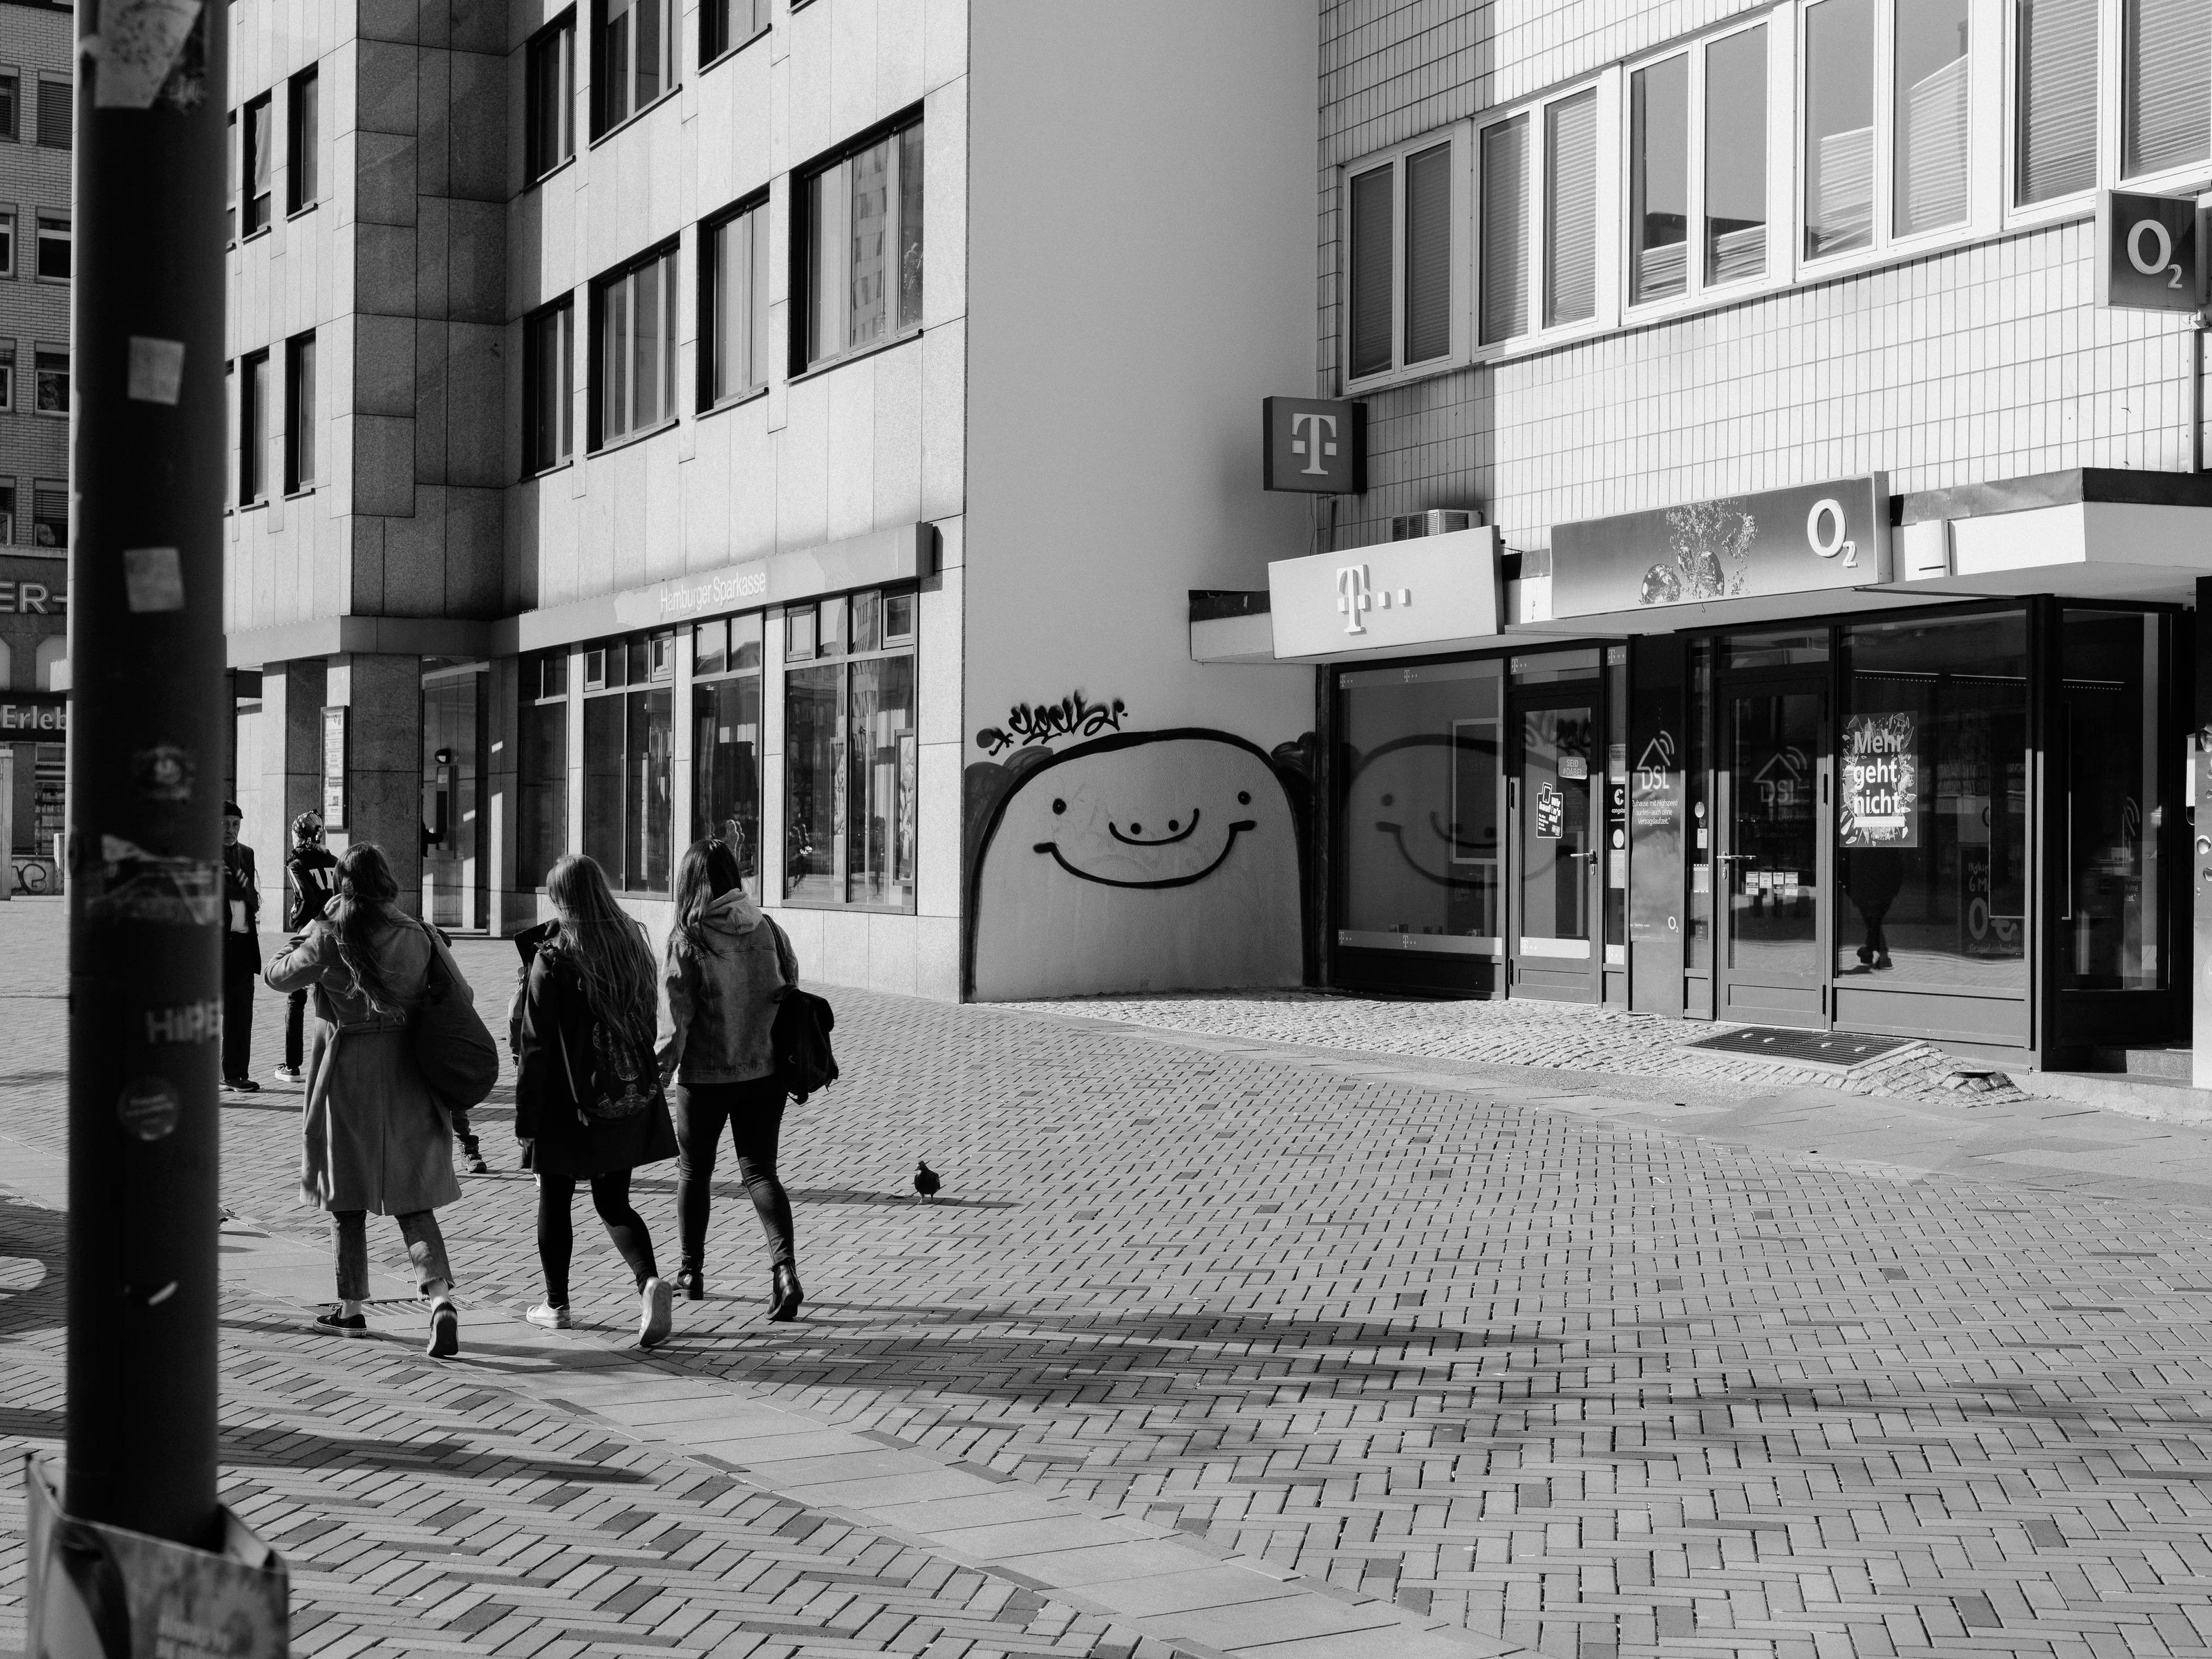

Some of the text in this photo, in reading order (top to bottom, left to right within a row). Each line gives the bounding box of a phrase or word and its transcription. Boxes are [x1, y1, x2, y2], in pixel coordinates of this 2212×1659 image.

[660, 572, 766, 612] Hamburger Sparkasse
[1854, 728, 1904, 753] Mehr
[1566, 758, 1579, 768] SEID
[1562, 767, 1582, 777] #DABEI
[1637, 765, 1670, 789] DSL
[1657, 799, 1678, 808] Highspeed
